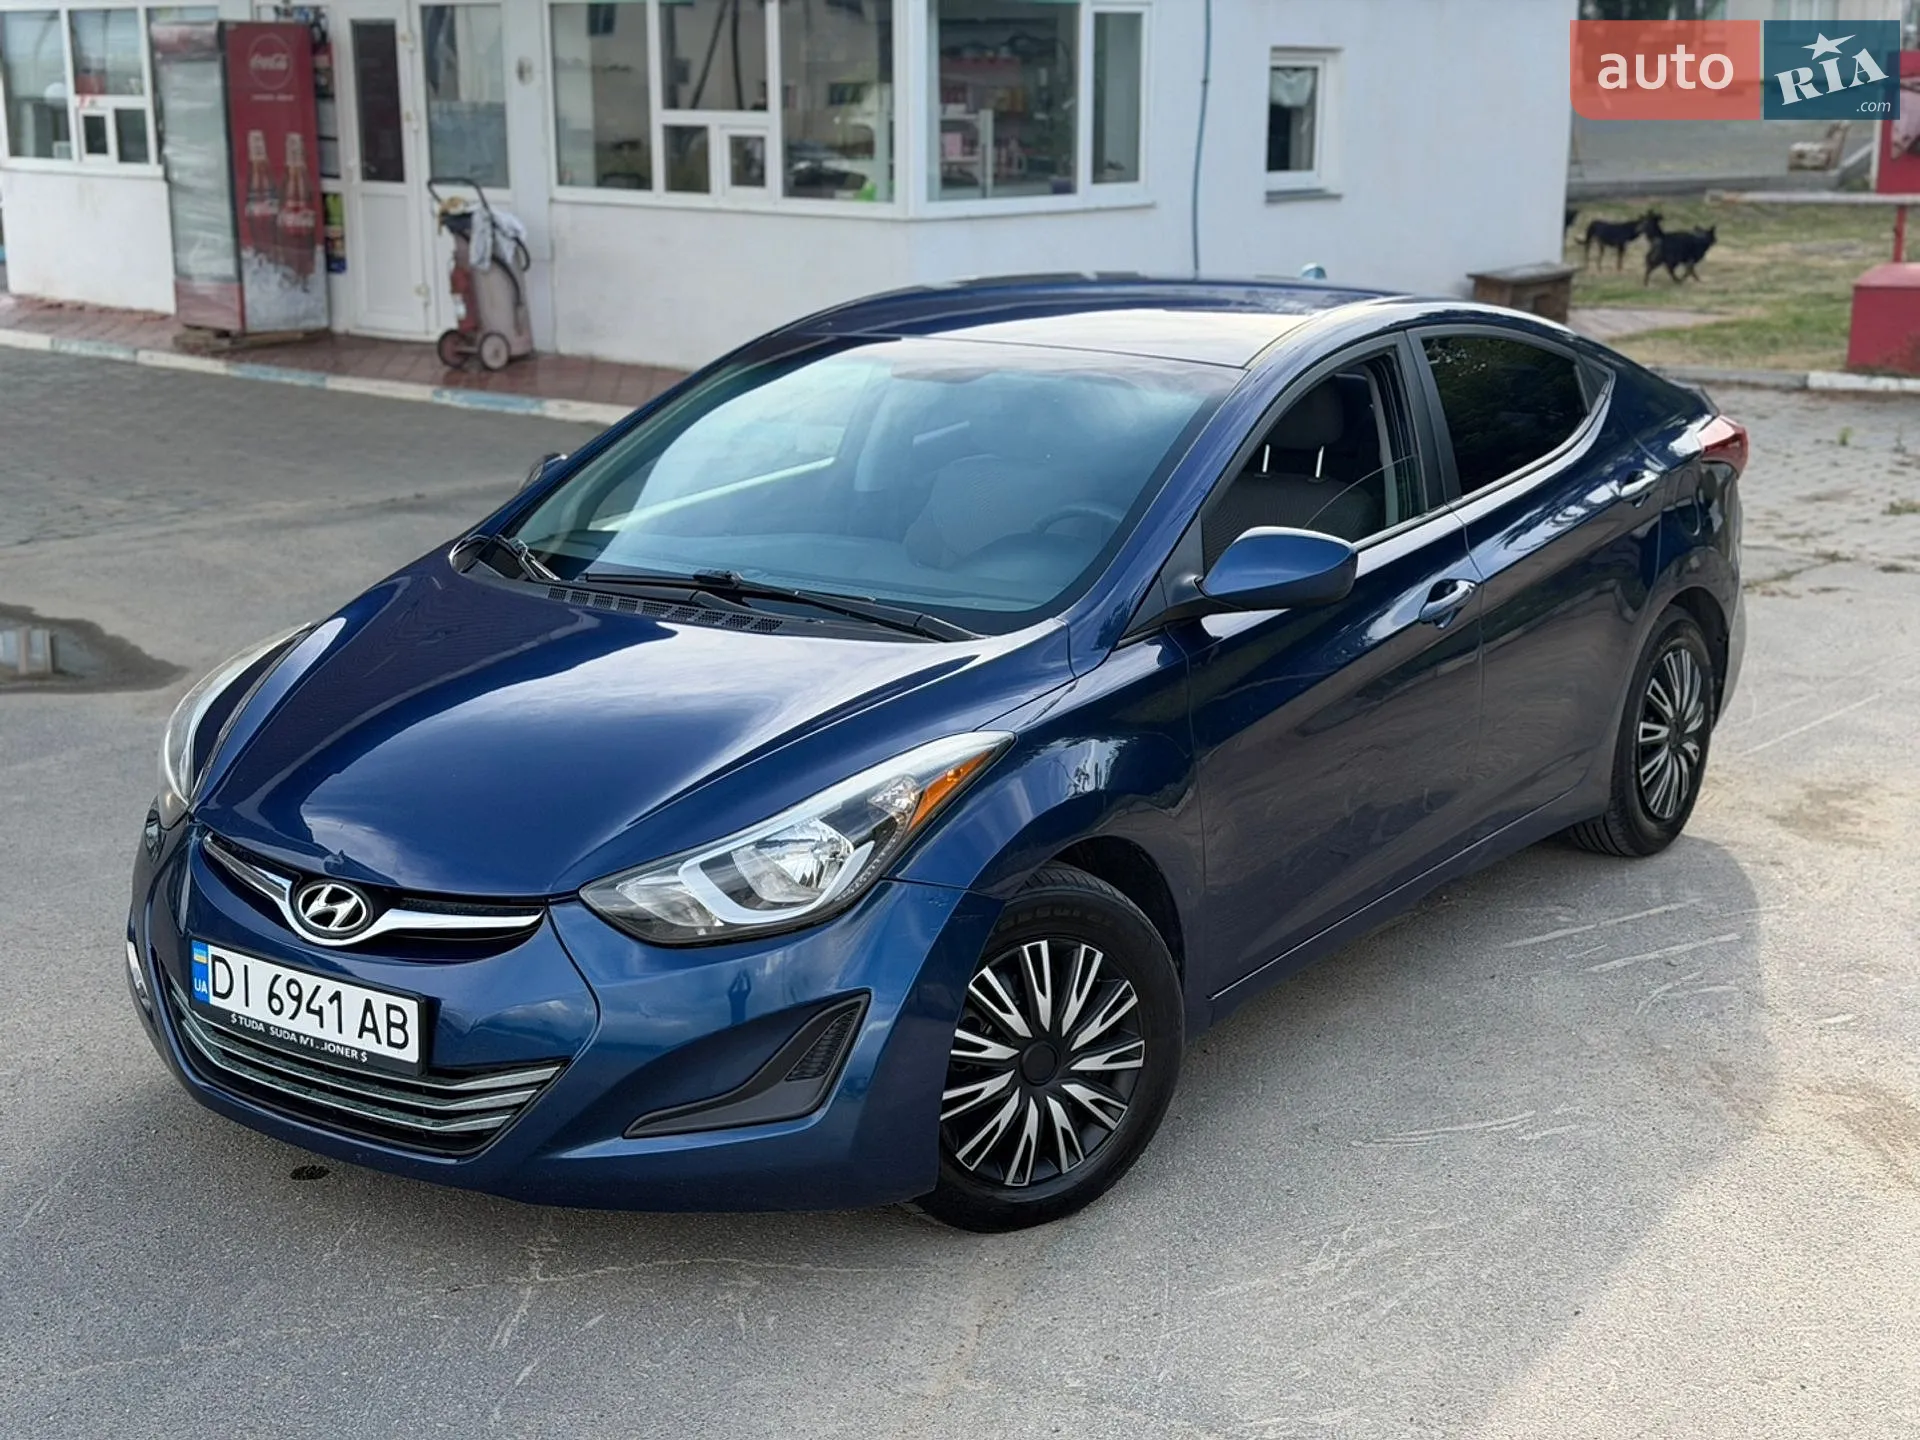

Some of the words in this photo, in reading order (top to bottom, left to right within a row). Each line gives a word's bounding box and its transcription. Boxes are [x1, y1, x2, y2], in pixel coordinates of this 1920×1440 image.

[194, 979, 208, 994] UA
[211, 953, 250, 1008] DI
[267, 973, 343, 1035] 6941
[357, 998, 410, 1051] AB
[269, 1025, 298, 1043] SUDA
